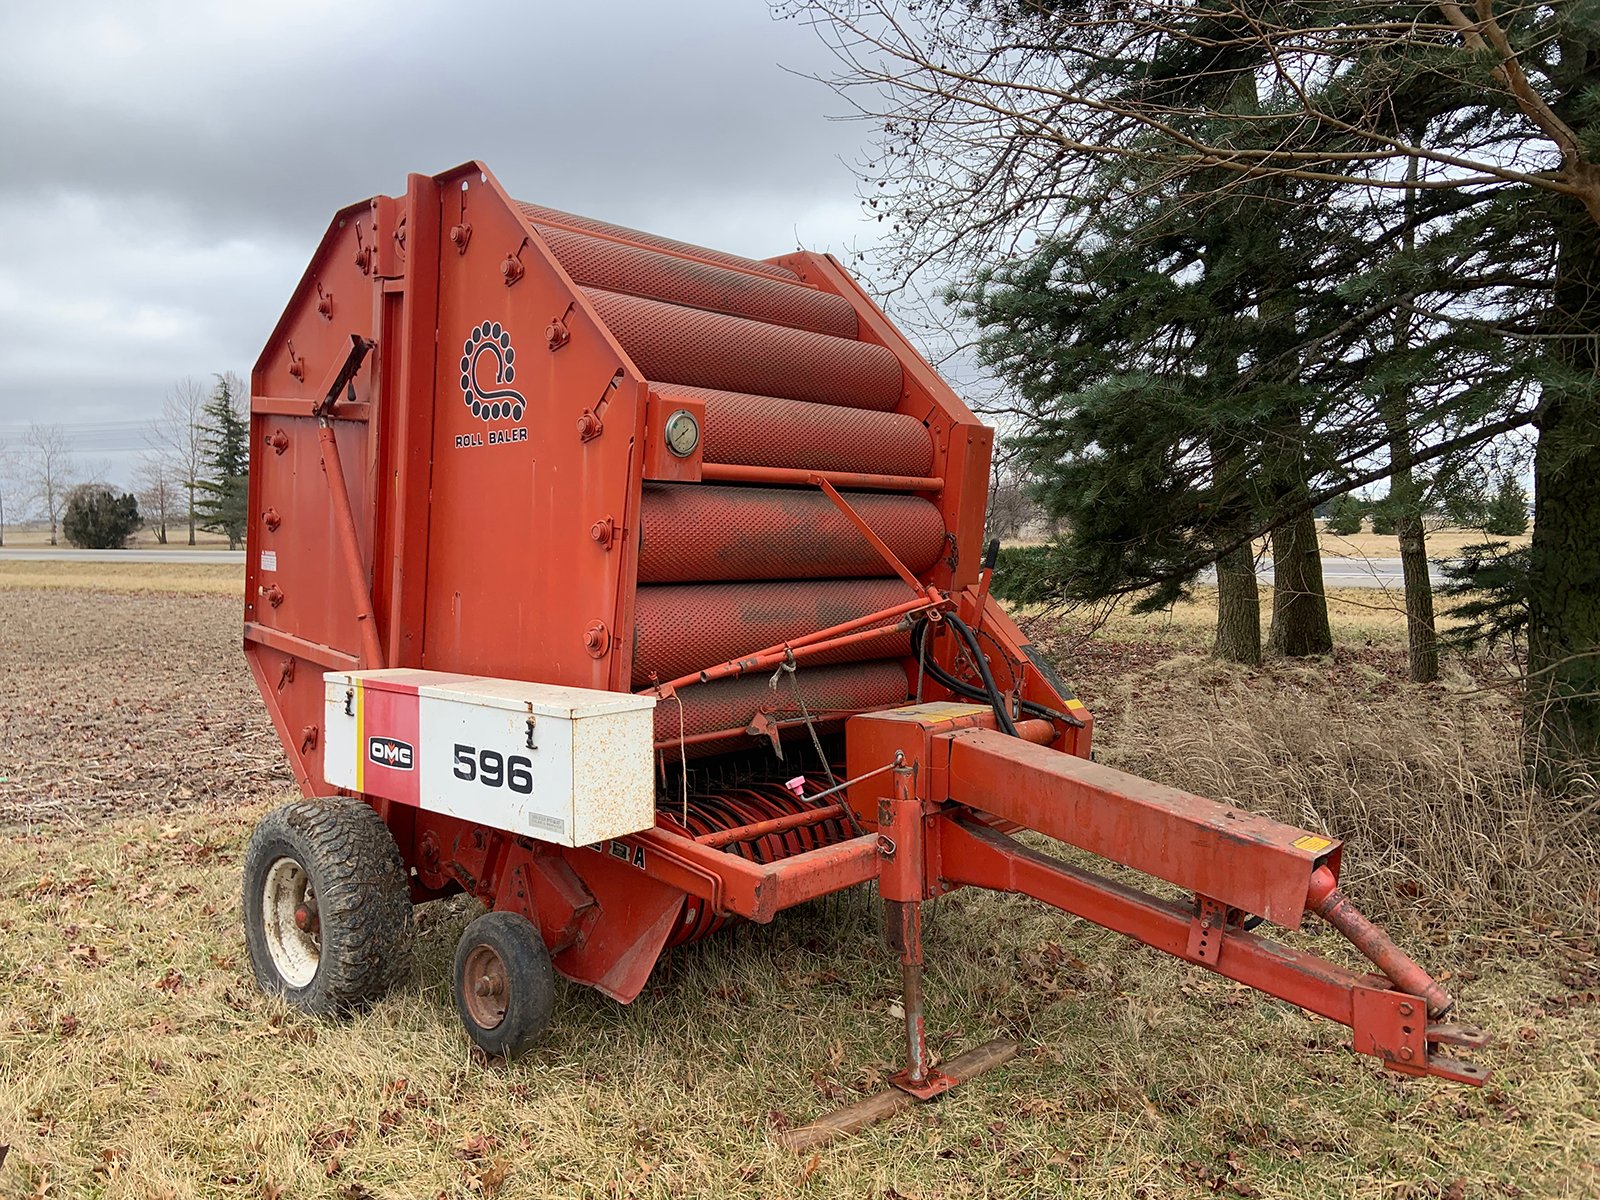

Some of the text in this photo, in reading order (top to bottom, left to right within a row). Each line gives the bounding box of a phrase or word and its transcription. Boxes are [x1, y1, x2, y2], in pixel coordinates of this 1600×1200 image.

[455, 427, 528, 448] ROLL BALER
[371, 742, 411, 764] OMC
[453, 743, 533, 794] 596
